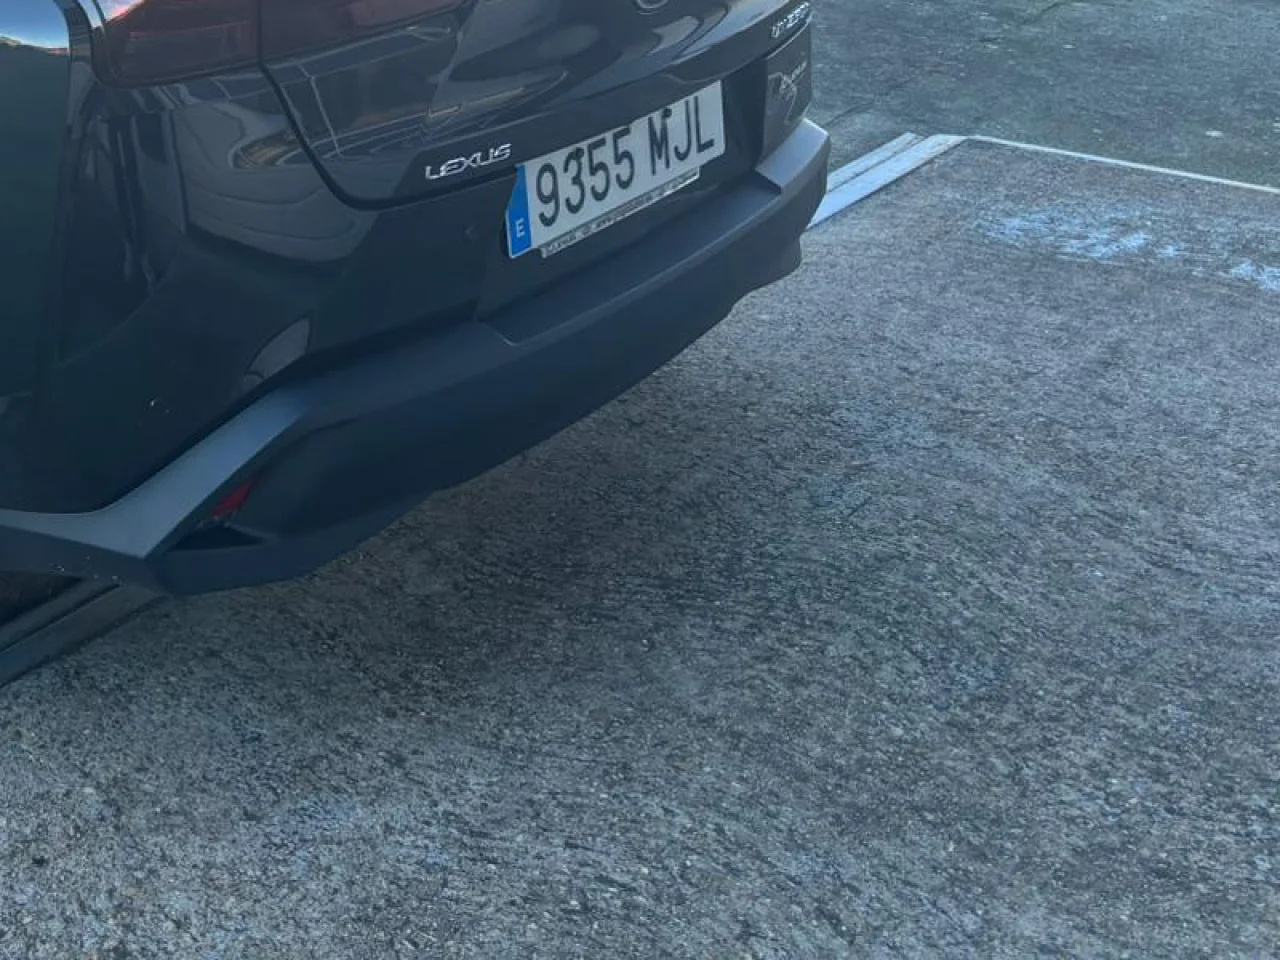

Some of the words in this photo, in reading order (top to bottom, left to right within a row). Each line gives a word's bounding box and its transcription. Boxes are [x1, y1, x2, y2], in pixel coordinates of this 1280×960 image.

[425, 144, 512, 180] LEXUS
[536, 126, 635, 228] 9355
[647, 95, 715, 176] MJL
[515, 217, 526, 238] E
